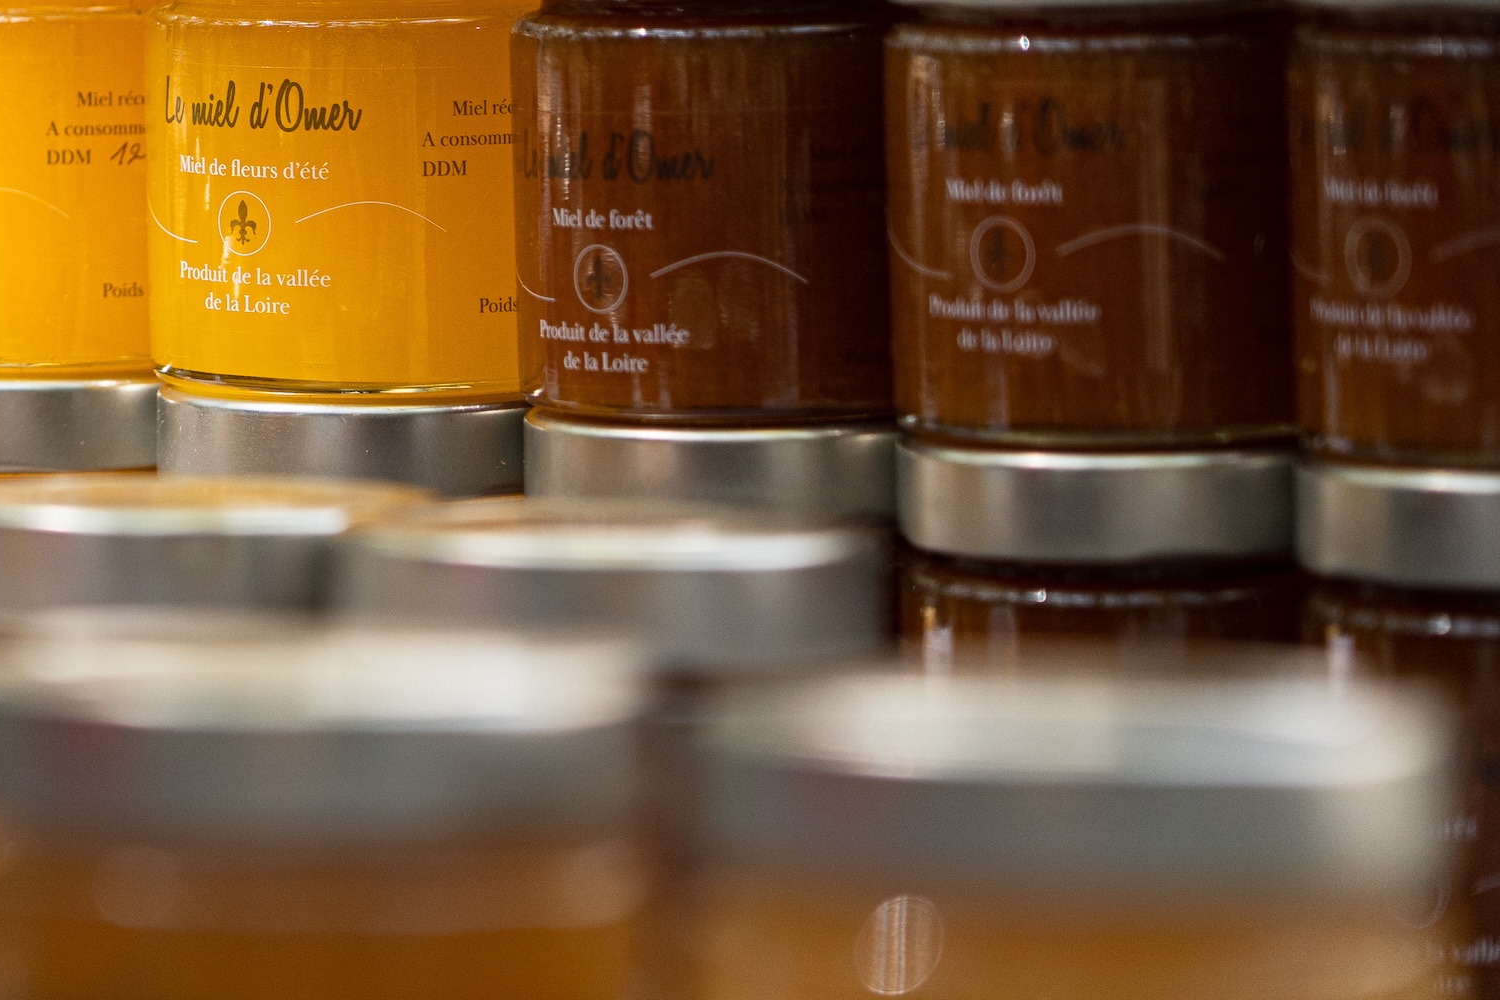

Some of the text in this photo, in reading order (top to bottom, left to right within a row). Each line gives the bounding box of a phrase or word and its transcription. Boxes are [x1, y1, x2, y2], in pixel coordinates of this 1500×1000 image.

[77, 91, 113, 107] Miel
[165, 74, 363, 133] Le miel d'Omer
[452, 100, 487, 117] Miel
[46, 120, 59, 136] A
[422, 131, 435, 147] A
[47, 149, 92, 165] DDM
[602, 129, 717, 183] d'Omer
[179, 154, 330, 181] Miel de fleurs d'été
[423, 160, 468, 177] DDM
[552, 207, 653, 231] Miel de forêt
[179, 260, 331, 288] Produit de la vallée
[102, 282, 145, 298] Poids
[205, 292, 291, 315] de la Loire
[479, 296, 519, 313] Poids
[539, 319, 690, 345] Produit de la vallée
[563, 351, 648, 374] de la Loire
